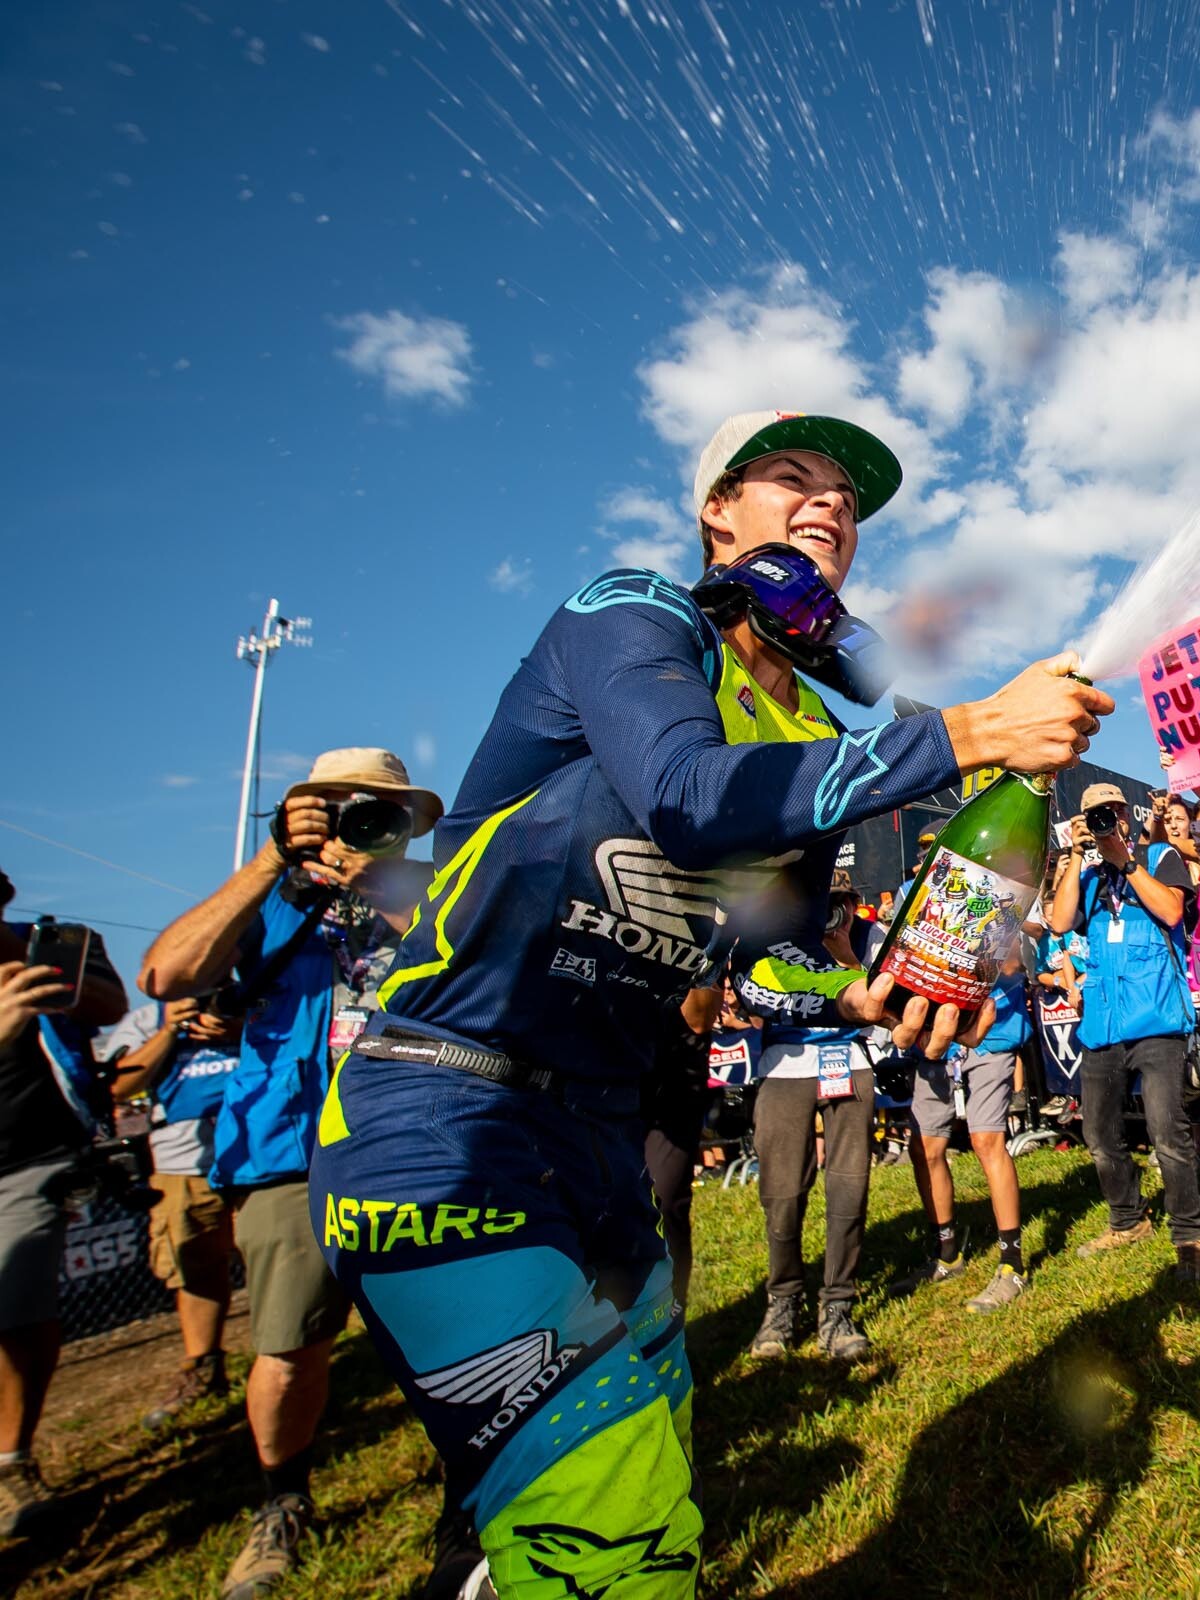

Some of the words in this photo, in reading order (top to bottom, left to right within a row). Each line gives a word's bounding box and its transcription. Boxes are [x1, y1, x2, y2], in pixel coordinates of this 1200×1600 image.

[750, 560, 790, 582] 100%
[970, 900, 991, 911] FOX
[561, 899, 710, 973] HOND
[920, 923, 952, 943] LUCAS
[951, 938, 968, 950] OIL
[709, 1051, 744, 1063] CER
[1053, 1024, 1077, 1060] X
[324, 1193, 526, 1252] ASTARS
[467, 1346, 584, 1450] HONDA
